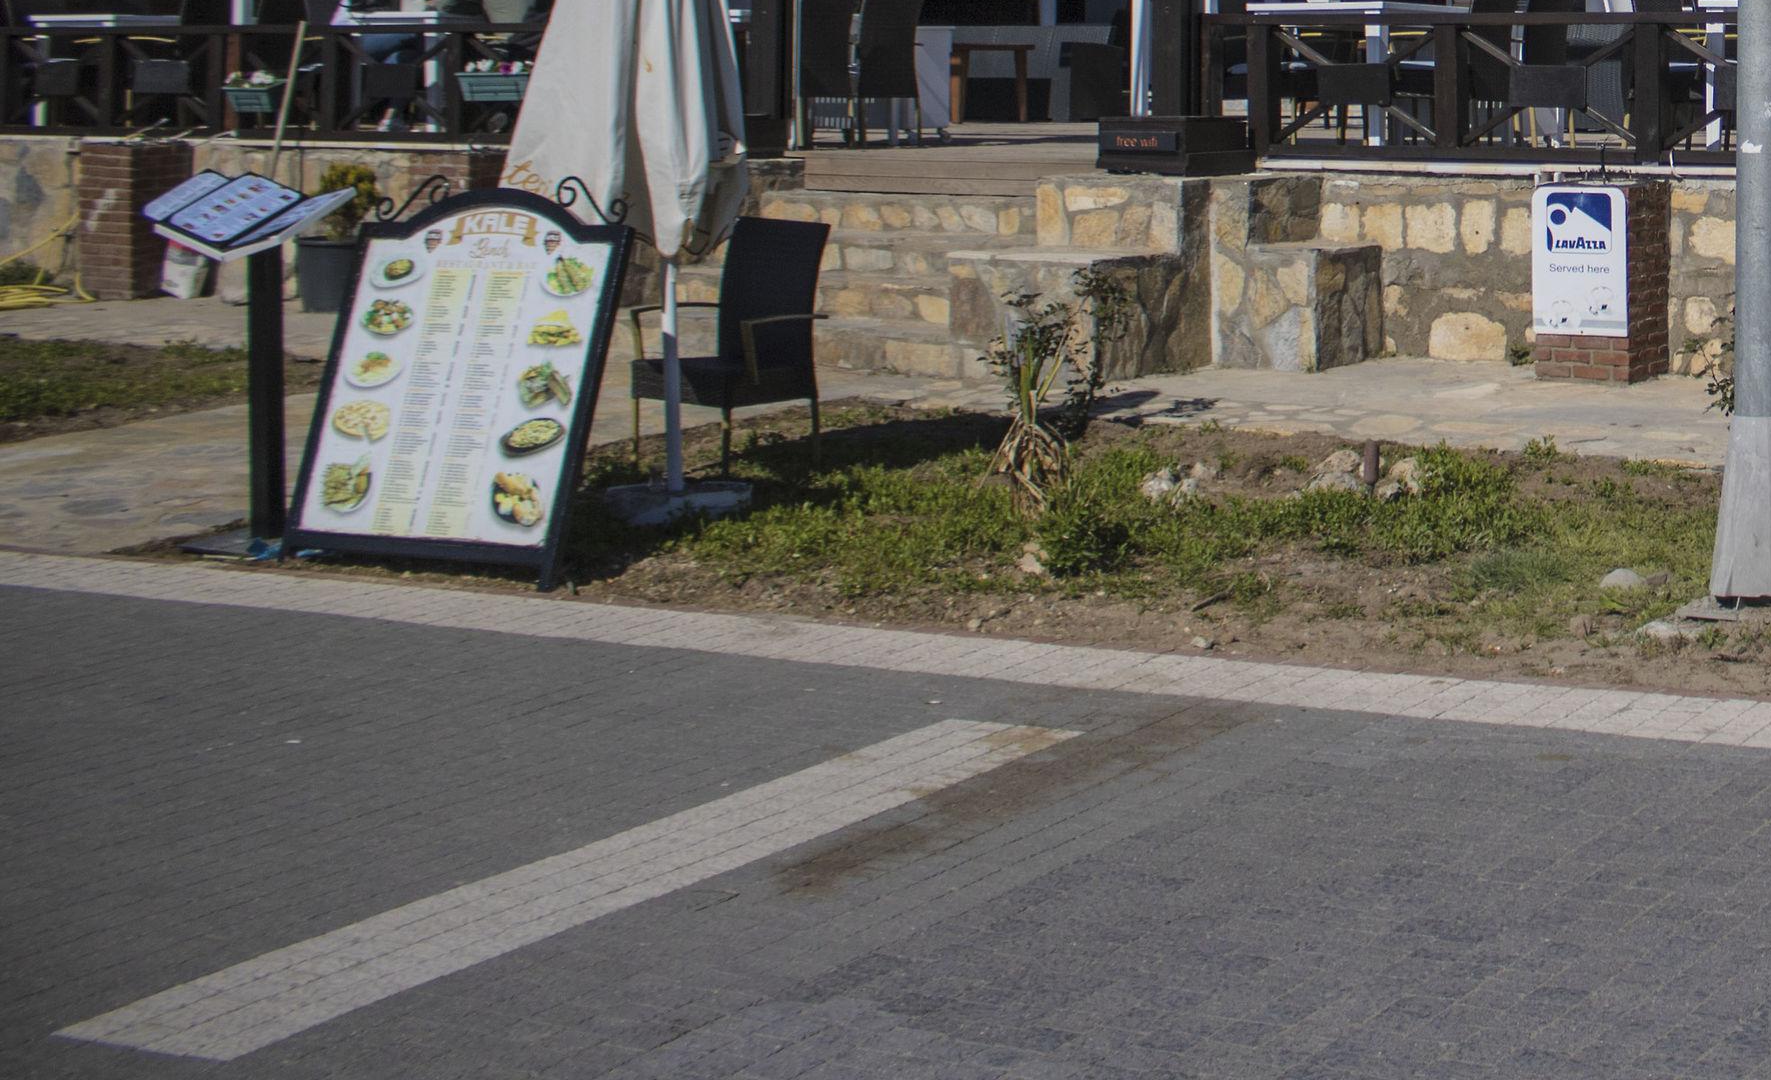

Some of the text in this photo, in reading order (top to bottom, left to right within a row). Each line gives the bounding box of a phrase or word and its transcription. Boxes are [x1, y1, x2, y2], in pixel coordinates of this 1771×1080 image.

[1116, 135, 1138, 148] free
[466, 213, 531, 234] KALE
[1555, 236, 1606, 250] LAVAZZA
[1549, 263, 1610, 274] Served here
